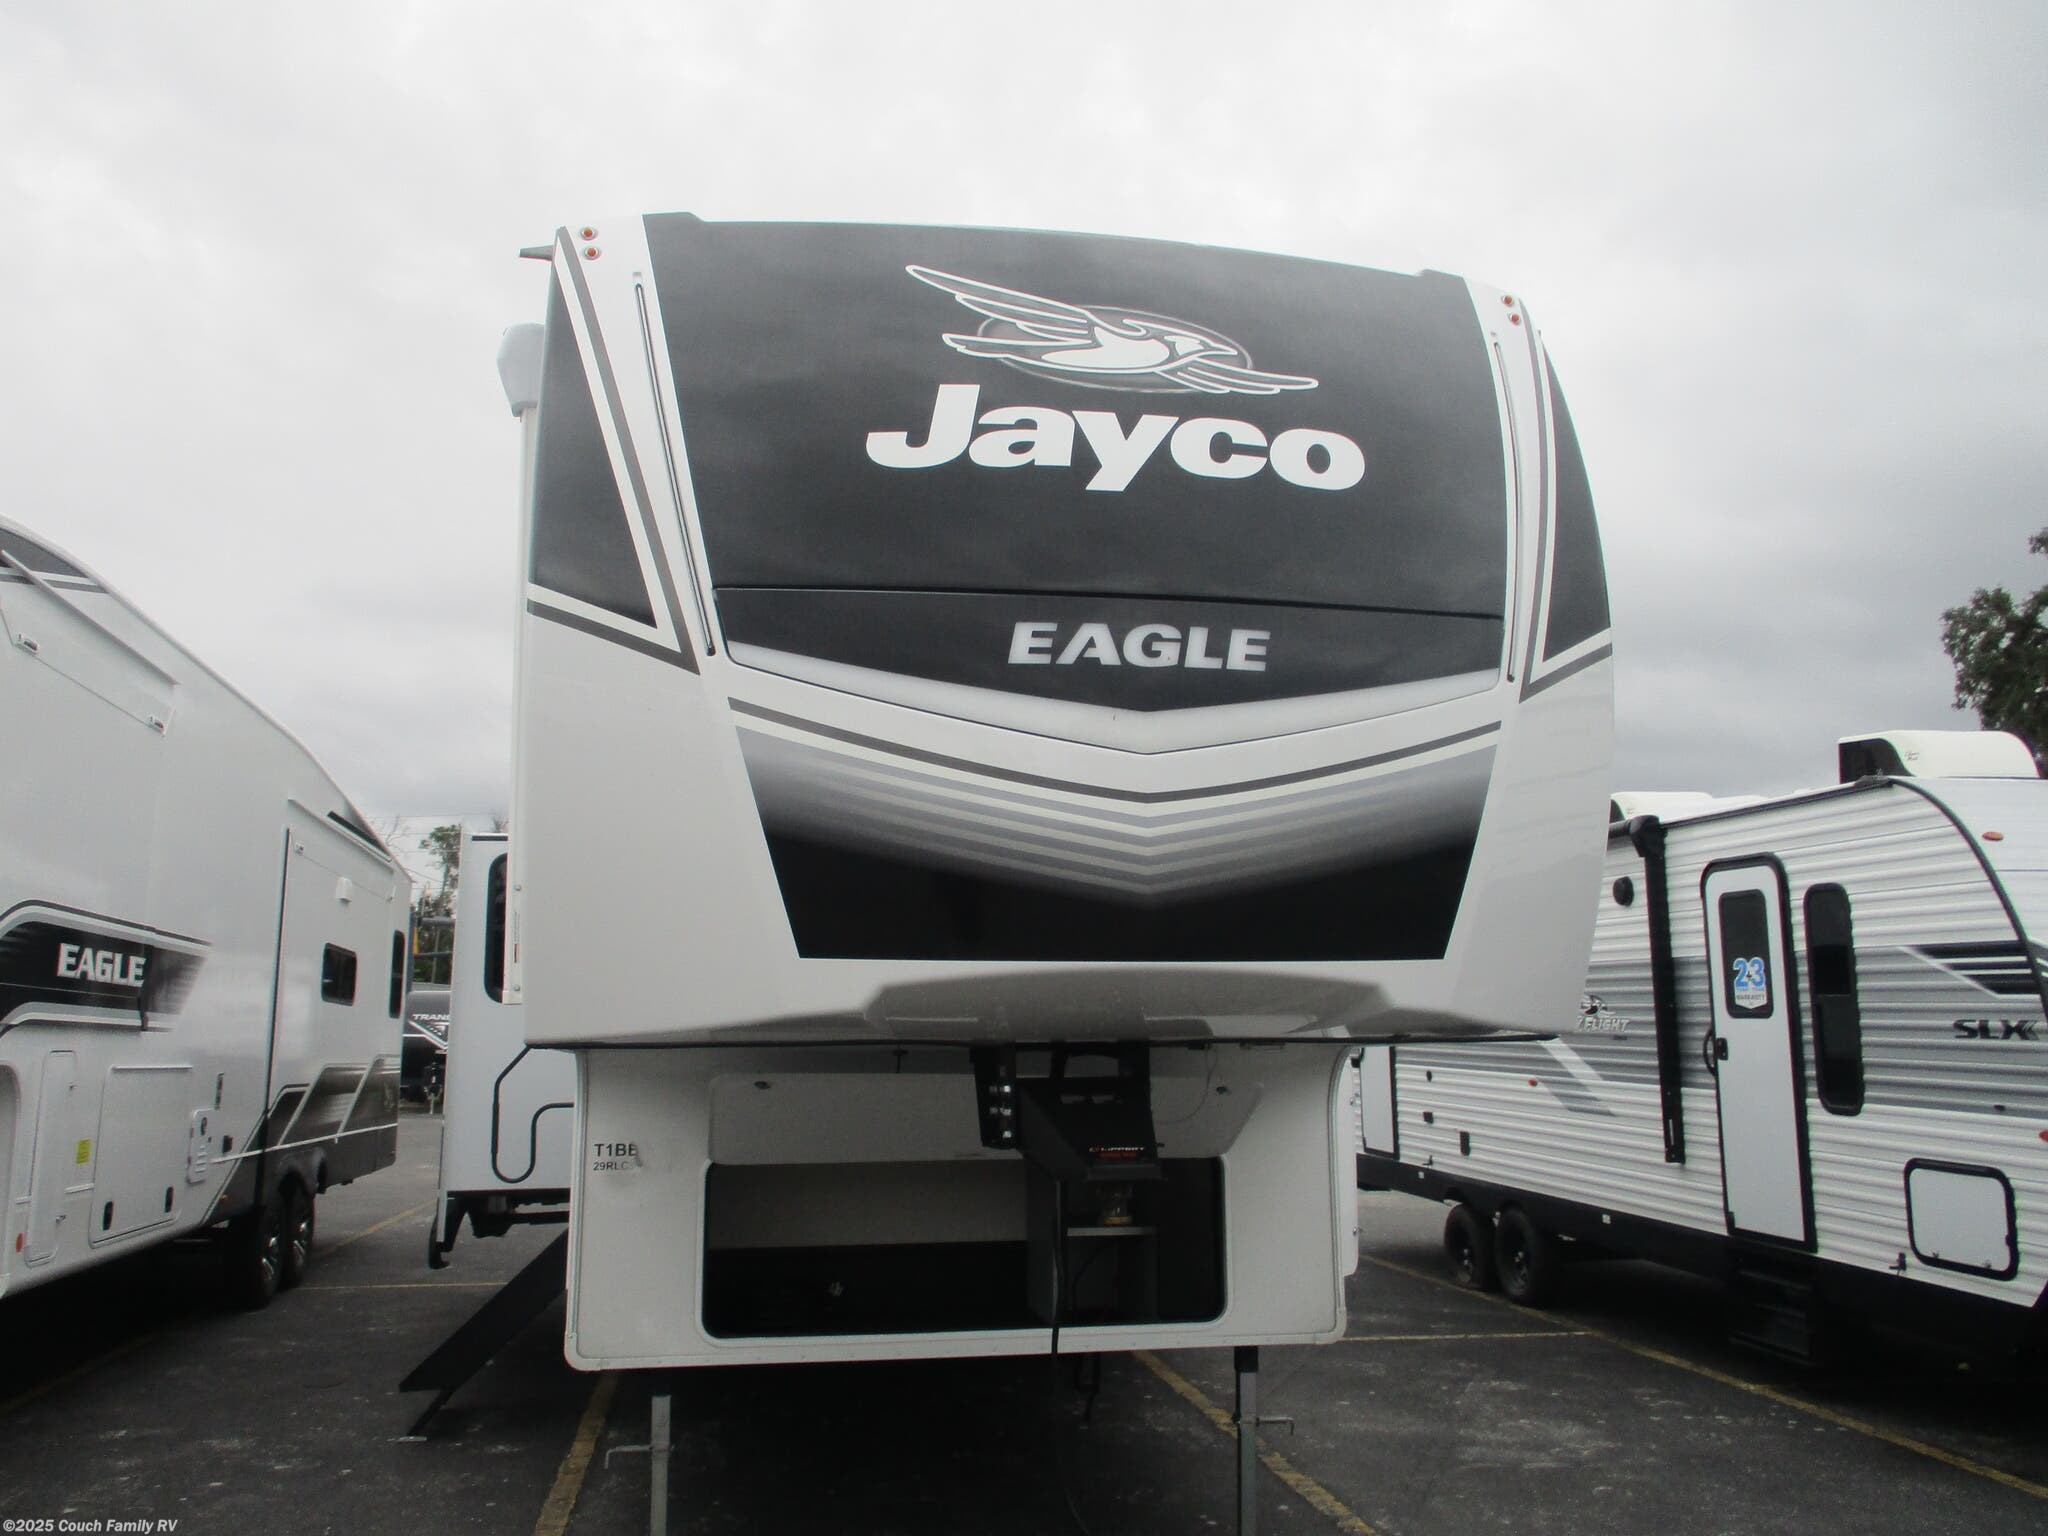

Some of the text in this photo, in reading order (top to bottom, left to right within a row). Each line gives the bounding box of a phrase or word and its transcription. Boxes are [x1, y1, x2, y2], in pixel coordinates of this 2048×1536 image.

[866, 384, 1366, 492] Jayco
[1007, 621, 1271, 672] EAGLE
[56, 942, 146, 988] EAGLE
[1953, 1019, 2040, 1041] SLX
